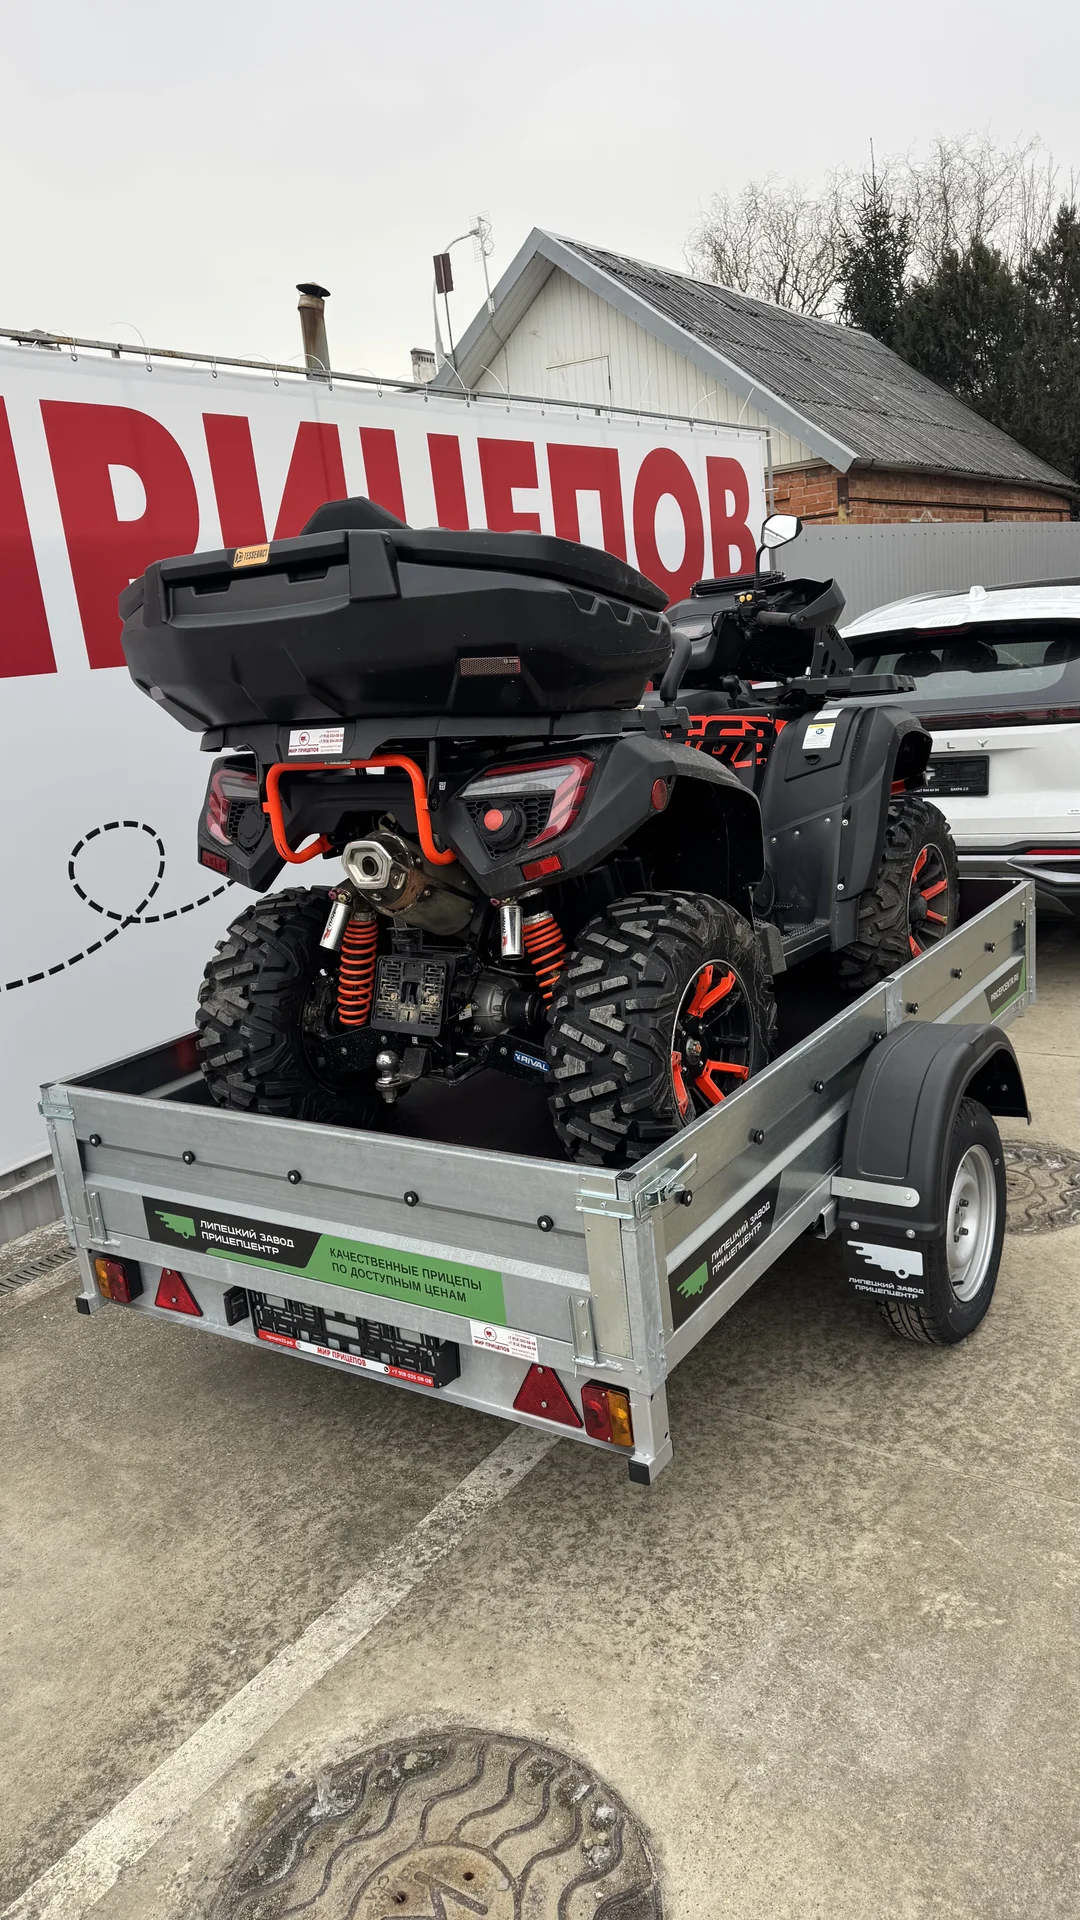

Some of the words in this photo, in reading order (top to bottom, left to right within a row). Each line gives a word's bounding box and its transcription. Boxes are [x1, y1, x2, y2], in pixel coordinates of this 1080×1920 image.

[0, 394, 757, 677] РИЦЕПОВ
[520, 1056, 548, 1072] RIVAL
[200, 1219, 257, 1241] ЛИПЕЦКИЙ
[259, 1233, 295, 1249] ЗАВОД
[201, 1231, 280, 1256] ПРИЦЕПЦЕНТР
[711, 1220, 749, 1263] ЛИПЕЦКИЙ
[749, 1200, 771, 1227] ЗАВОД
[712, 1221, 762, 1276] ПРИЦЕПЦЕНТР
[329, 1247, 419, 1277] КАЧЕСТВЕННЫЕ
[421, 1268, 483, 1292] ПРИЦЕПЫ
[331, 1262, 348, 1275] ПО
[350, 1266, 422, 1293] ДОСТУПНЫМ
[424, 1282, 468, 1303] ЦЕНАМ
[848, 1277, 894, 1290] ЛИПЕЦКИЙ
[896, 1284, 925, 1295] ЗАВОД
[855, 1284, 918, 1299] ПРИЦЕПЦЕНТР
[316, 1347, 331, 1357] МИР
[331, 1350, 367, 1367] ПРИЦЕПОВ
